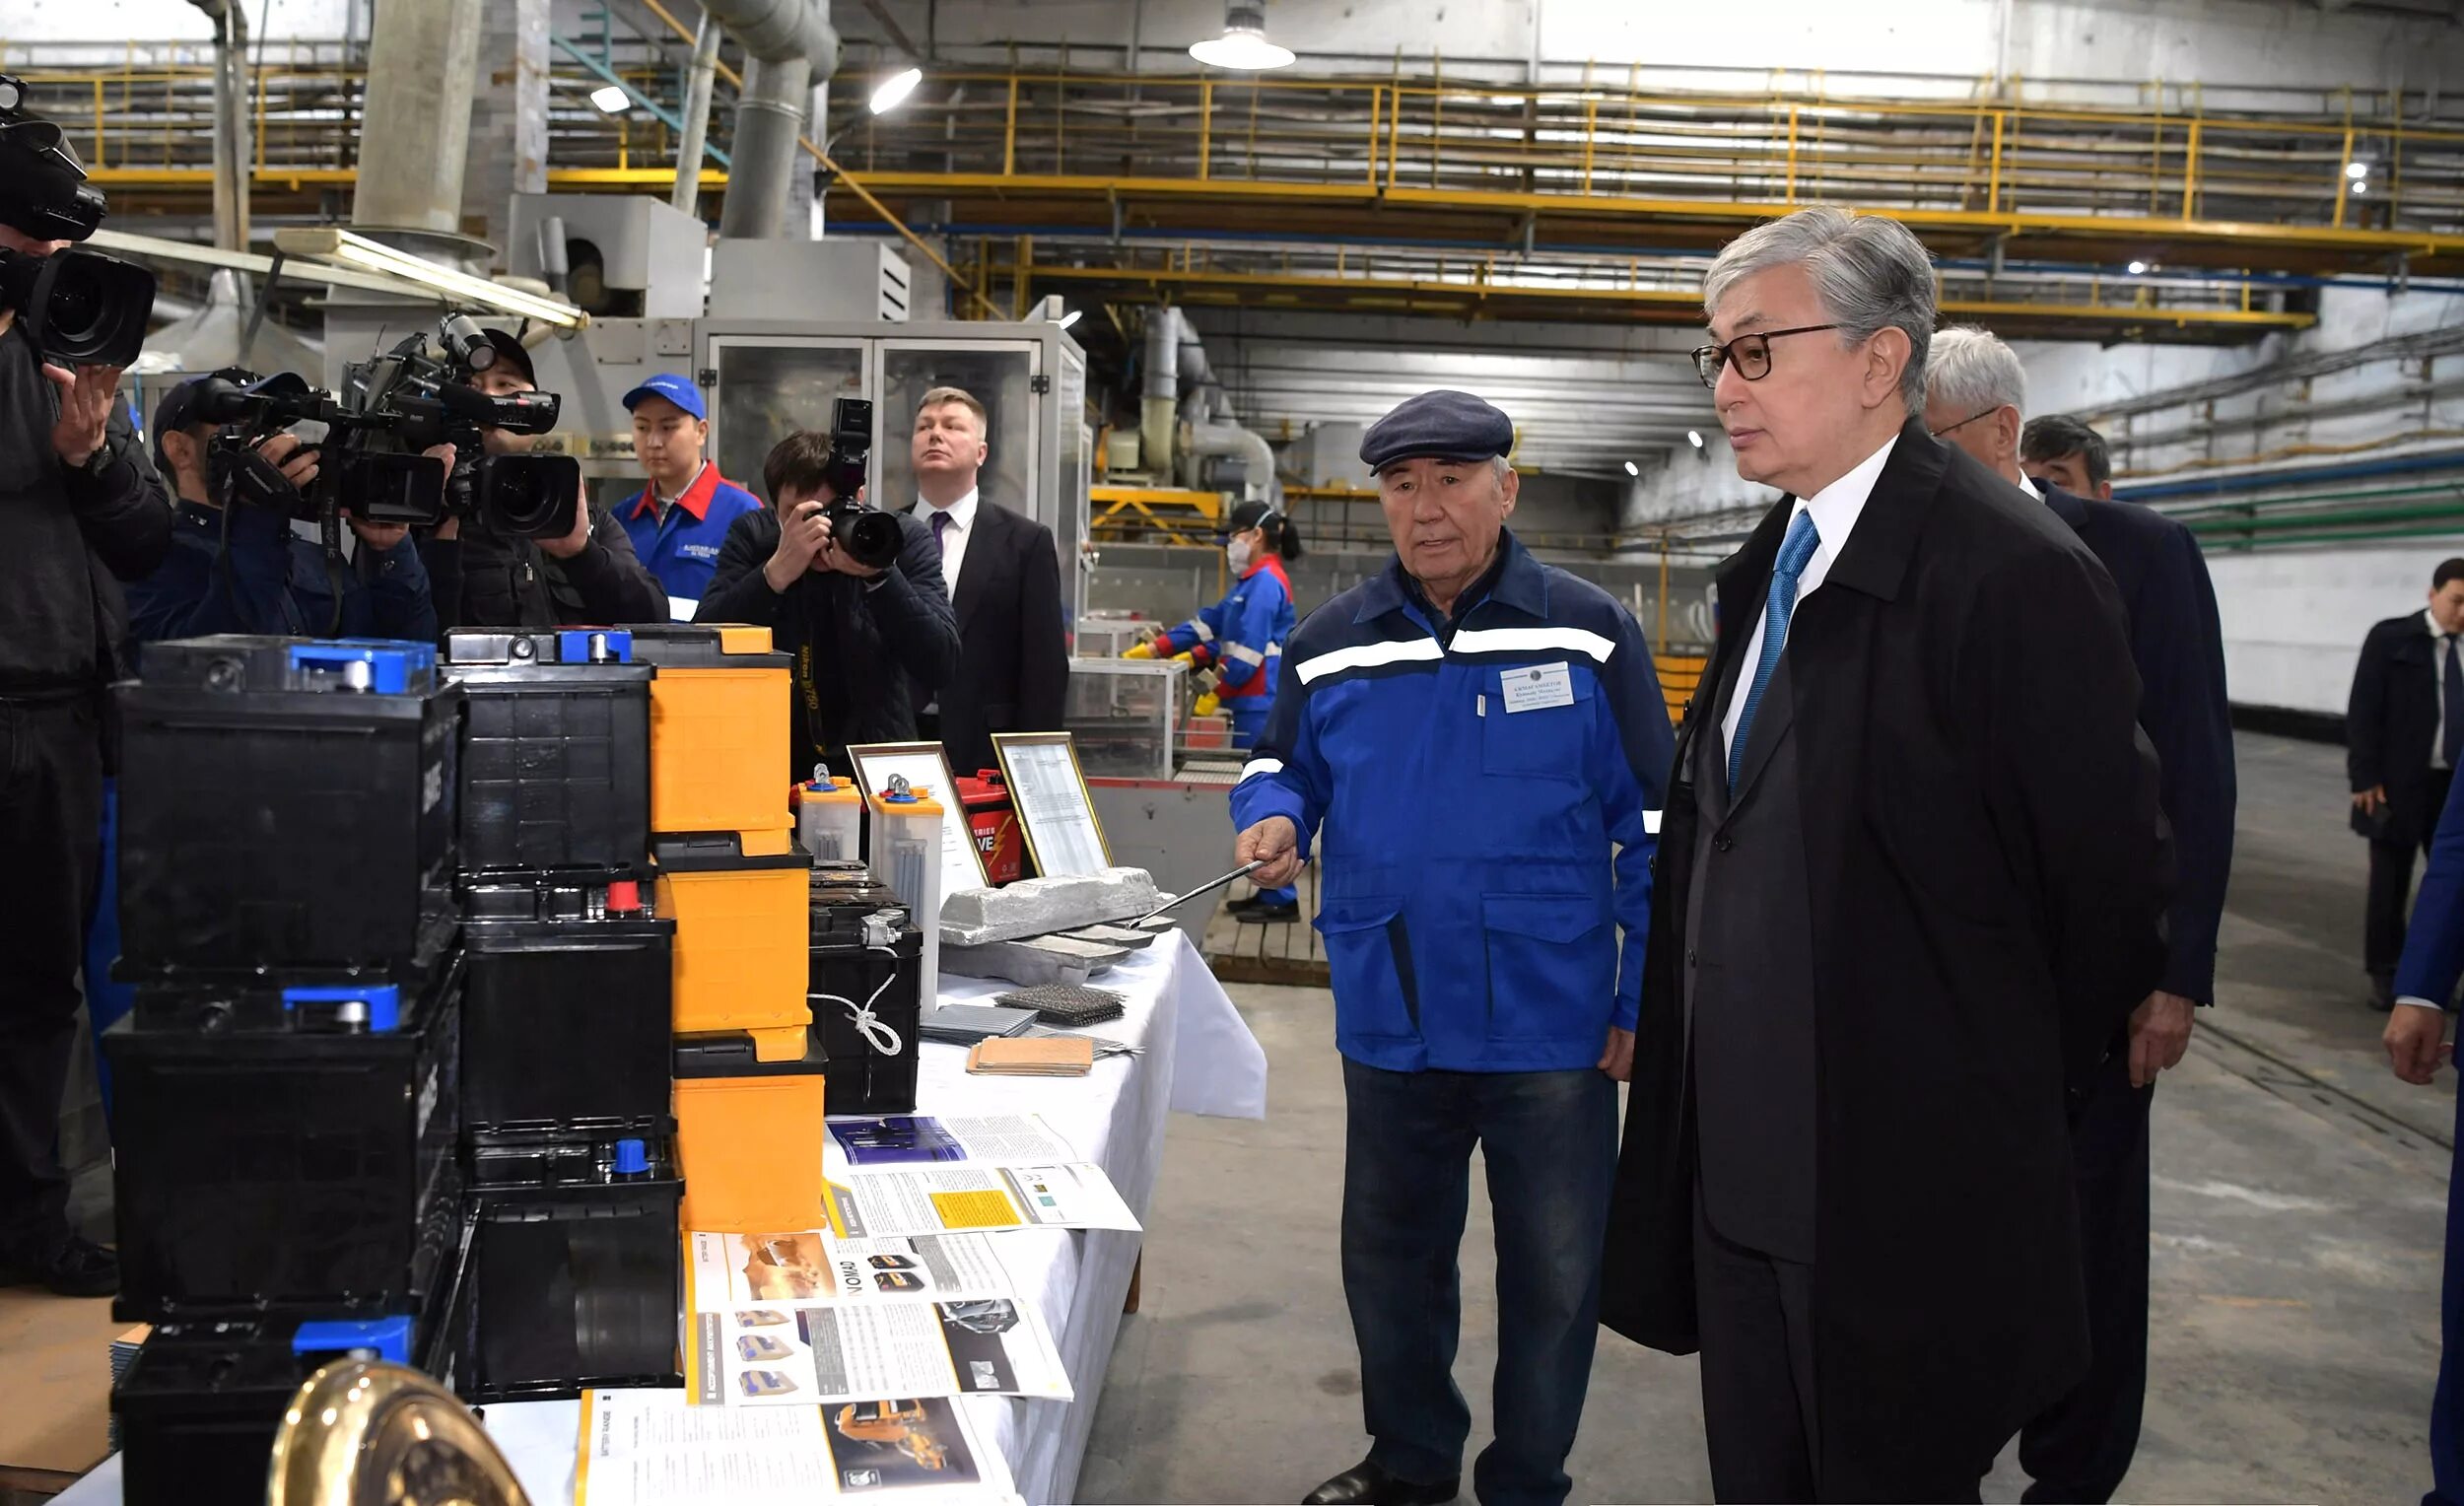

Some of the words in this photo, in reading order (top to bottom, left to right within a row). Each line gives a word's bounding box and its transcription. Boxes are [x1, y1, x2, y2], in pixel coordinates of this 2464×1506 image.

[801, 645, 810, 678] Nikon
[974, 826, 995, 837] ERIES
[977, 836, 994, 852] VE
[840, 1261, 863, 1296] NOMAD
